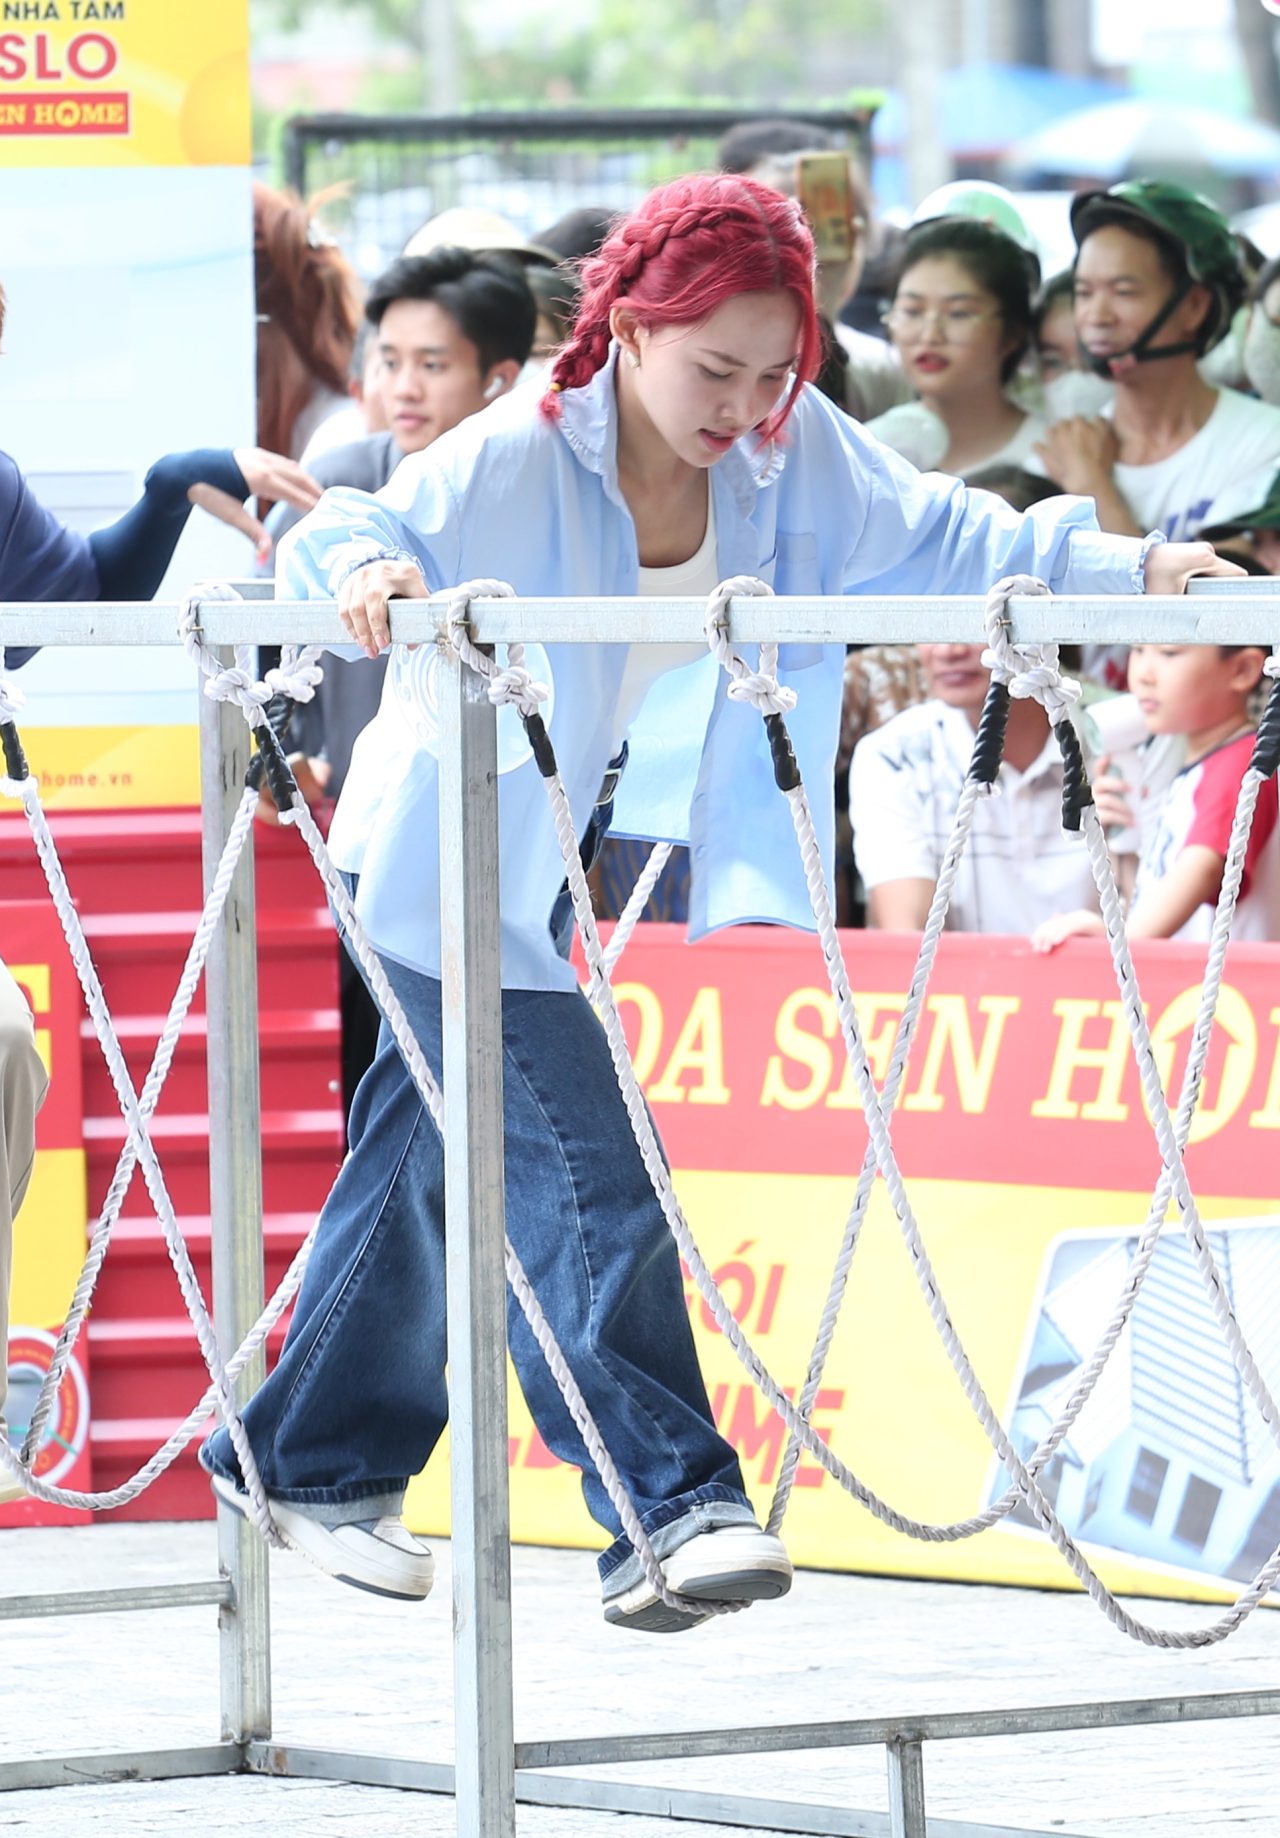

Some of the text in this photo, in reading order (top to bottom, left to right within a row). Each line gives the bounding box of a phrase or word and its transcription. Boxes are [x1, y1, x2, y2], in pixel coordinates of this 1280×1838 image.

[33, 100, 125, 128] HOME
[760, 987, 1019, 1113] SEN
[1030, 981, 1280, 1144] HO
[680, 1240, 785, 1335] ÓI
